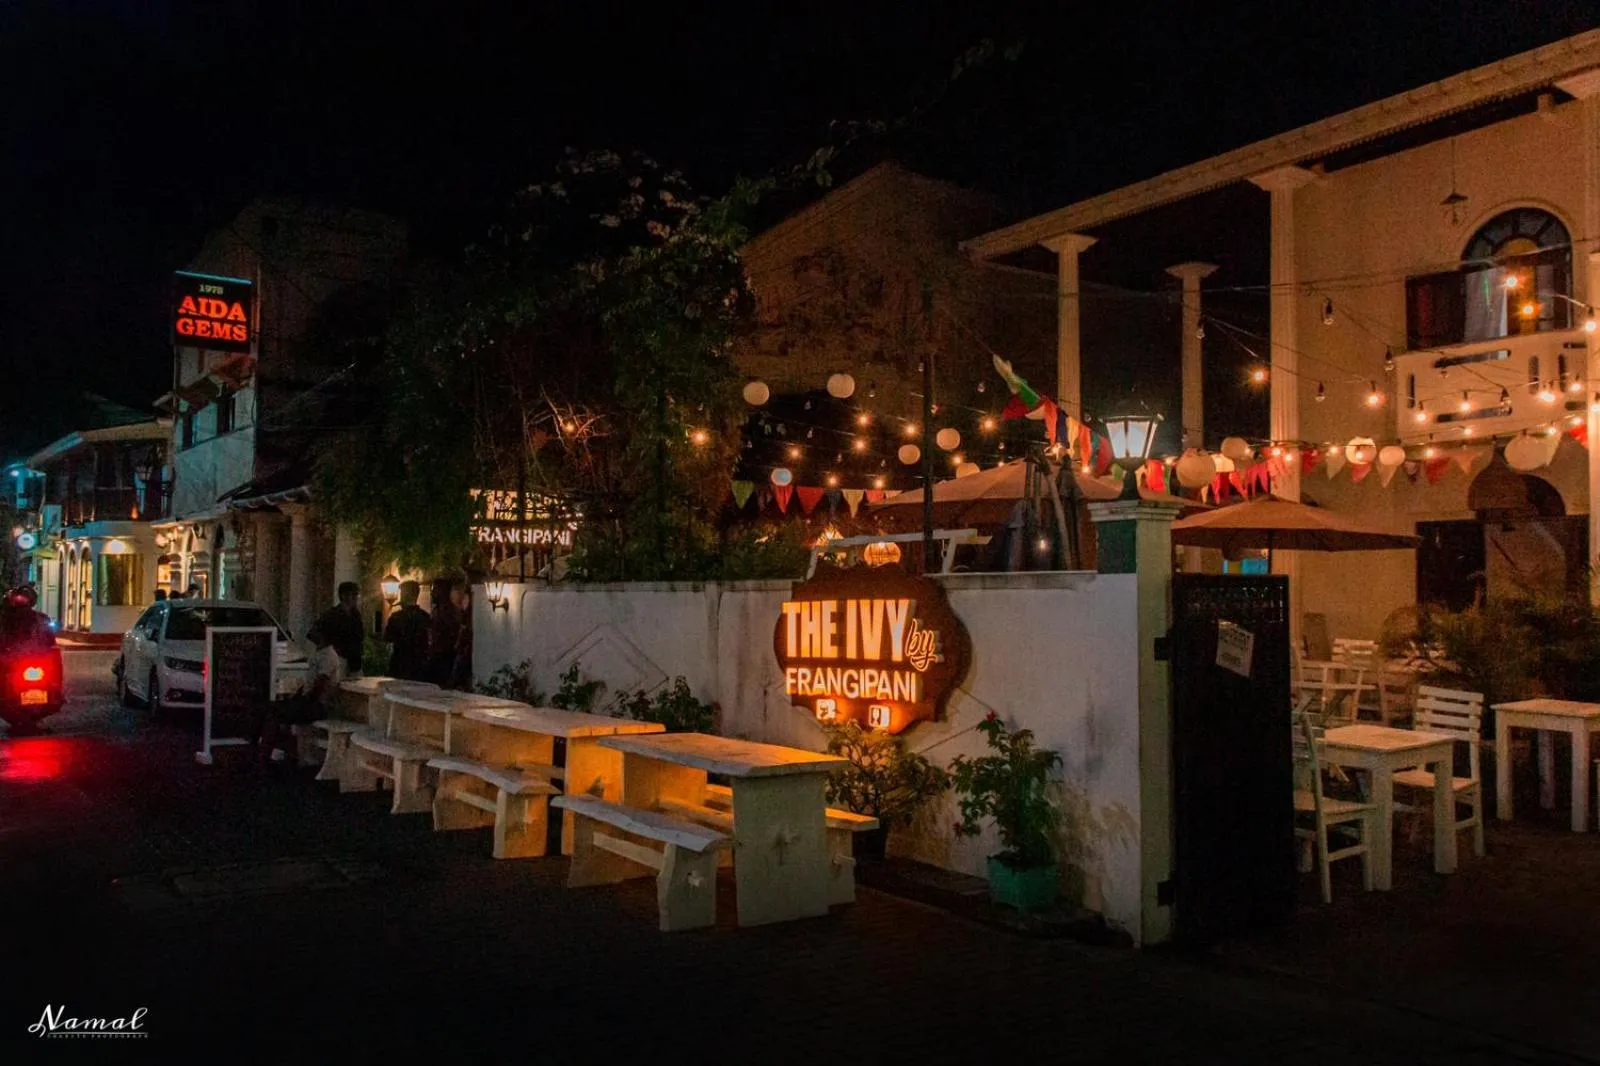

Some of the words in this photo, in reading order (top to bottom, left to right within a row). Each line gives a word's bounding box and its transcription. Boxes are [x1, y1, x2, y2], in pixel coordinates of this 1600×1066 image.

[178, 296, 247, 322] AIDA
[176, 318, 247, 341] GEMS
[782, 600, 839, 658] THE
[845, 599, 911, 661] IVY
[904, 618, 939, 672] by
[786, 667, 917, 703] FRANGIPANI
